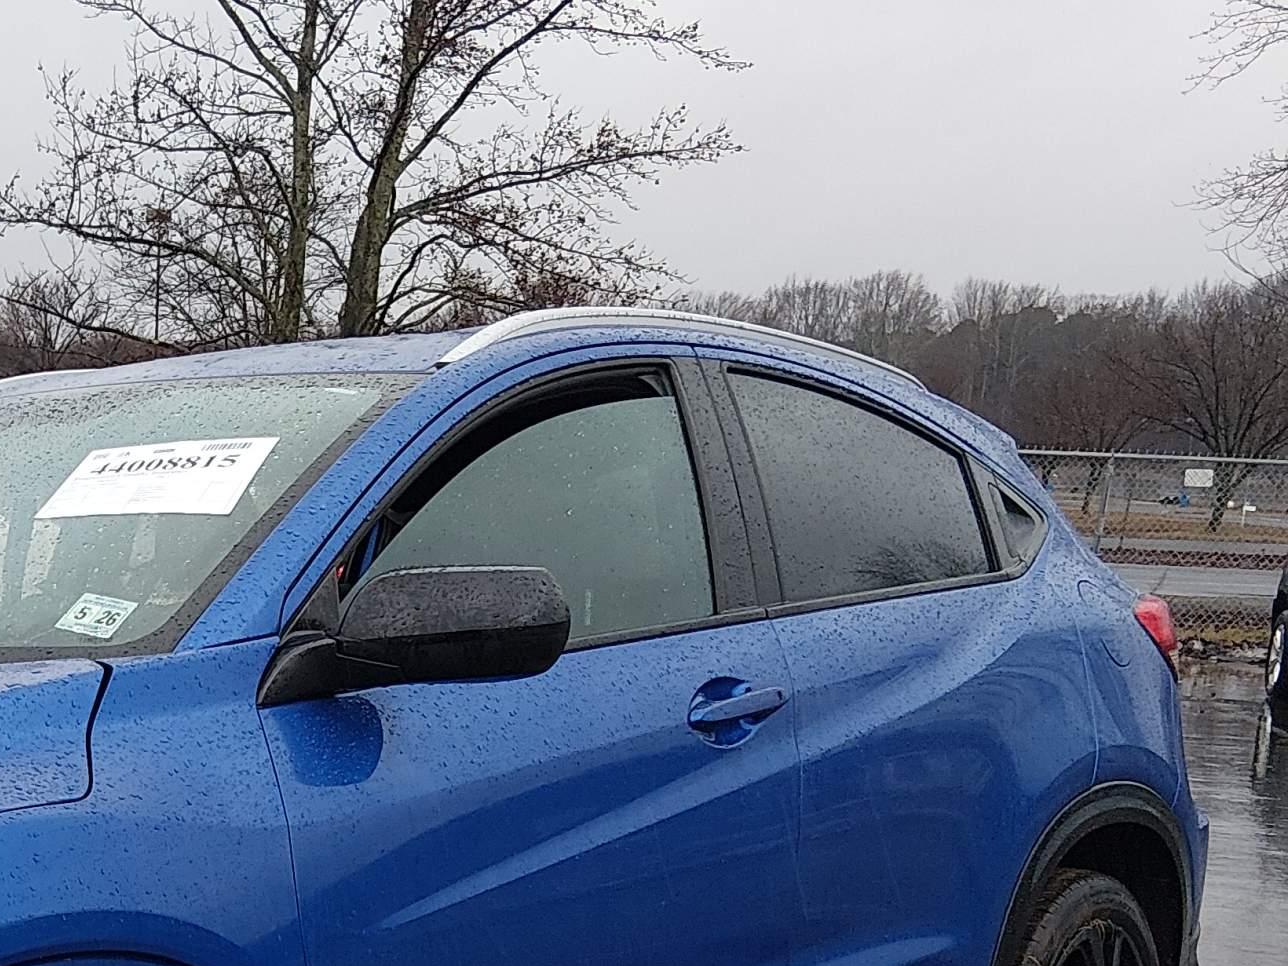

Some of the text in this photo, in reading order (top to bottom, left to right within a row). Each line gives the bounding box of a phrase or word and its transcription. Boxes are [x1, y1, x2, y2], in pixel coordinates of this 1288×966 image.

[90, 454, 242, 474] 44008815
[74, 605, 91, 620] 5
[93, 610, 121, 626] 26
